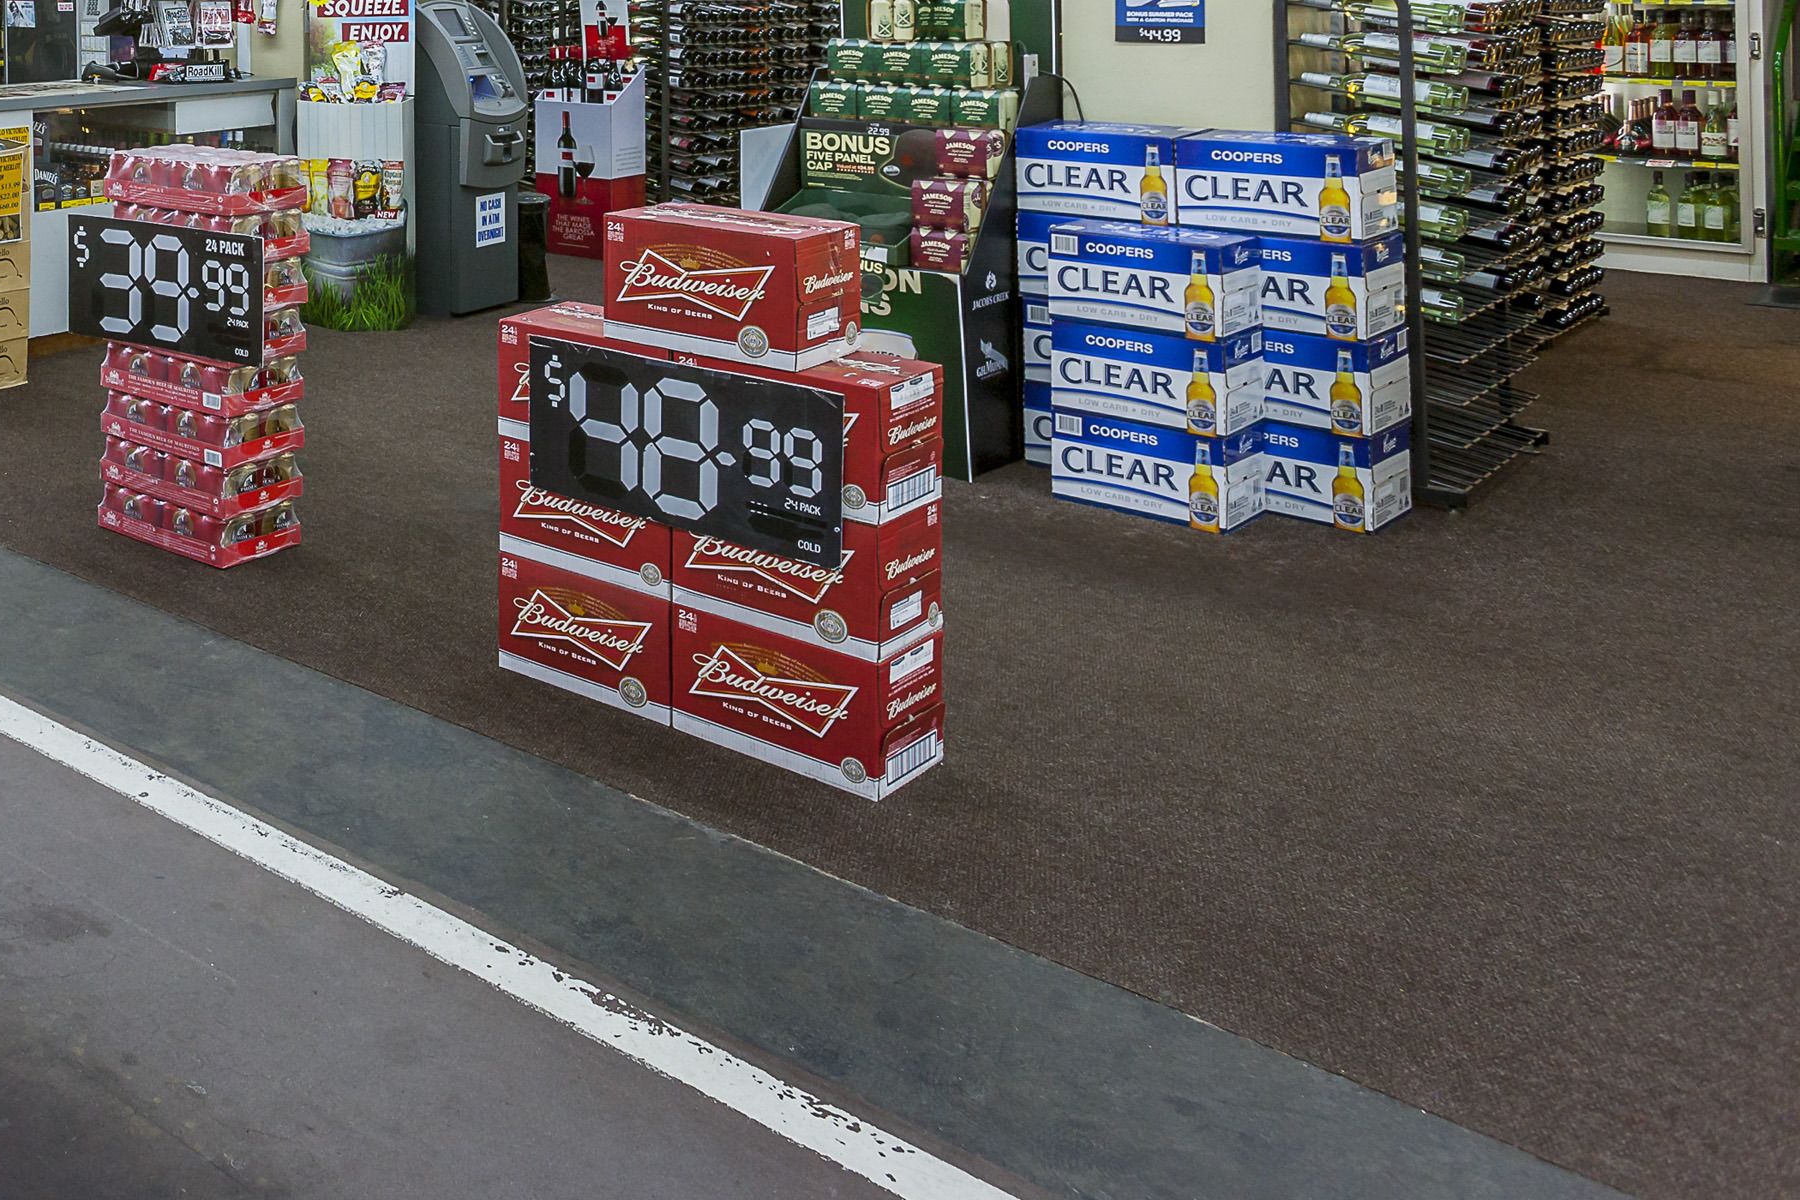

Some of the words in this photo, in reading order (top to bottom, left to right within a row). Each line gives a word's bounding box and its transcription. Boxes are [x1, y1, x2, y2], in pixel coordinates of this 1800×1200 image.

[324, 0, 404, 17] SQUEEZE.
[349, 24, 405, 40] ENJOY.
[1139, 28, 1181, 42] $44.99
[837, 49, 864, 58] JAMESON
[883, 51, 911, 60] JAMESON
[931, 52, 960, 63] JAMESON
[188, 67, 222, 77] RoadKill
[868, 127, 890, 135] 22.99
[806, 132, 890, 155] BONUS
[1047, 140, 1109, 154] COOPERS
[807, 151, 833, 160] FIVE
[835, 153, 875, 164] PANEL
[1211, 150, 1283, 165] COOPERS
[807, 161, 832, 170] CAP
[1024, 163, 1132, 194] CLEAR
[1184, 174, 1308, 208] CLEAR
[480, 200, 487, 211] NO
[488, 198, 501, 210] CASH
[1141, 202, 1168, 211] CLEAR
[482, 215, 487, 226] IN
[488, 213, 499, 224] ATM
[572, 222, 591, 230] MADE
[607, 221, 620, 231] 24
[1206, 214, 1229, 223] LOW
[1234, 216, 1259, 225] CARB
[1271, 219, 1292, 228] DRY
[1320, 216, 1350, 226] CLEAR
[478, 227, 503, 242] OVERNIGHT
[565, 227, 595, 236] BAROSSA
[205, 238, 218, 252] 24
[219, 239, 245, 257] PACK
[1085, 243, 1154, 260] COOPERS
[620, 258, 766, 303] Budweiser
[803, 271, 854, 295] Budweiser
[1057, 265, 1176, 304] CLEAR
[993, 291, 1010, 303] CREEK
[648, 302, 668, 313] KING
[671, 307, 681, 315] OF
[684, 309, 713, 320] BEERS
[1185, 311, 1214, 324] CLEAR
[236, 318, 249, 329] PACK
[1085, 334, 1154, 355] COOPERS
[234, 347, 249, 358] COLD
[1059, 357, 1176, 400] CLEAR
[888, 415, 938, 445] Budweiser
[1089, 424, 1158, 447] COOPERS
[1061, 445, 1179, 492] CLEAR
[516, 479, 647, 531] Budweiser
[783, 497, 798, 510] 24
[799, 502, 822, 517] PACK
[797, 539, 822, 554] COLD
[501, 557, 515, 569] 24
[513, 596, 643, 655] Budweiser
[692, 652, 849, 721] Budweiser
